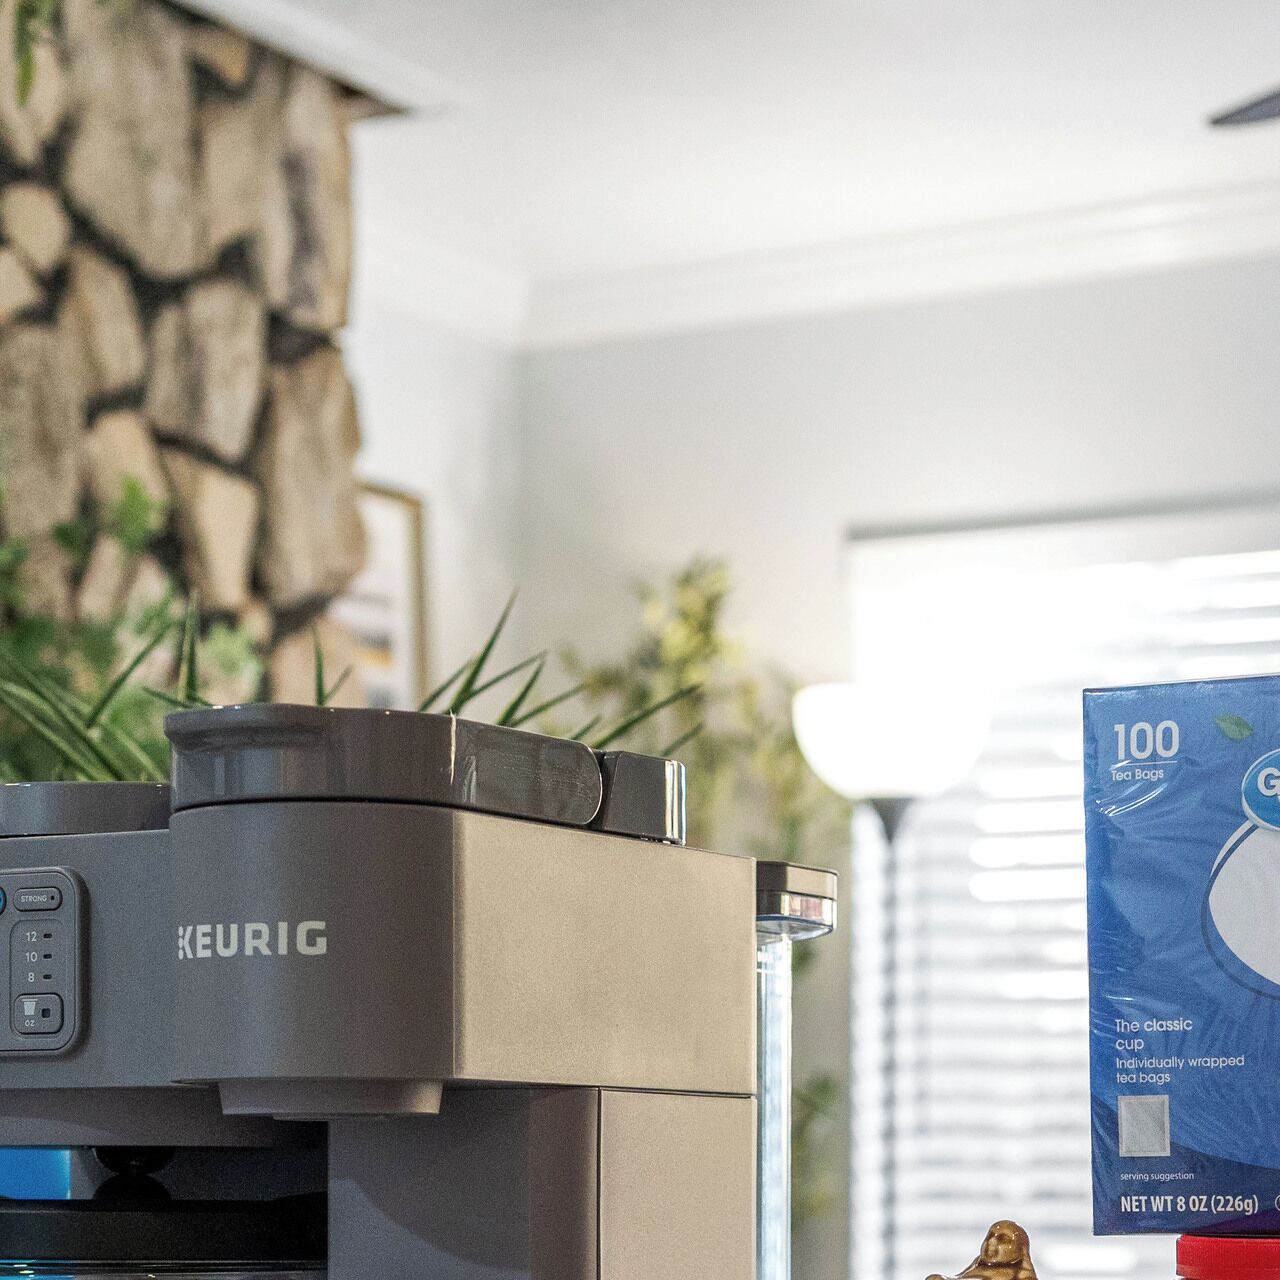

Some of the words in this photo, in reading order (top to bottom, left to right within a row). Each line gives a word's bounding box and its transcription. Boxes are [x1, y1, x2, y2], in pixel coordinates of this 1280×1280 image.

[1113, 720, 1180, 761] 100
[1111, 770, 1132, 782] Tea
[1135, 768, 1165, 782] Bags
[20, 894, 48, 903] STRONG
[25, 931, 38, 942] 12
[177, 920, 328, 961] KEURIG
[25, 951, 38, 963] 10
[27, 971, 36, 983] 8
[24, 1019, 36, 1027] OZ
[1115, 1019, 1140, 1033] The
[1144, 1018, 1194, 1032] classic
[1116, 1039, 1145, 1052] cup
[1116, 1057, 1185, 1070] Individually
[1188, 1055, 1245, 1068] wrapped
[1116, 1074, 1136, 1084] tea
[1139, 1073, 1171, 1086] bags
[1120, 1172, 1149, 1182] serving
[1150, 1171, 1195, 1181] suggestion
[1121, 1196, 1147, 1213] NET
[1150, 1196, 1173, 1213] WT
[1176, 1196, 1186, 1213] 8
[1189, 1196, 1208, 1213] OZ
[1211, 1195, 1259, 1215] (226g)
